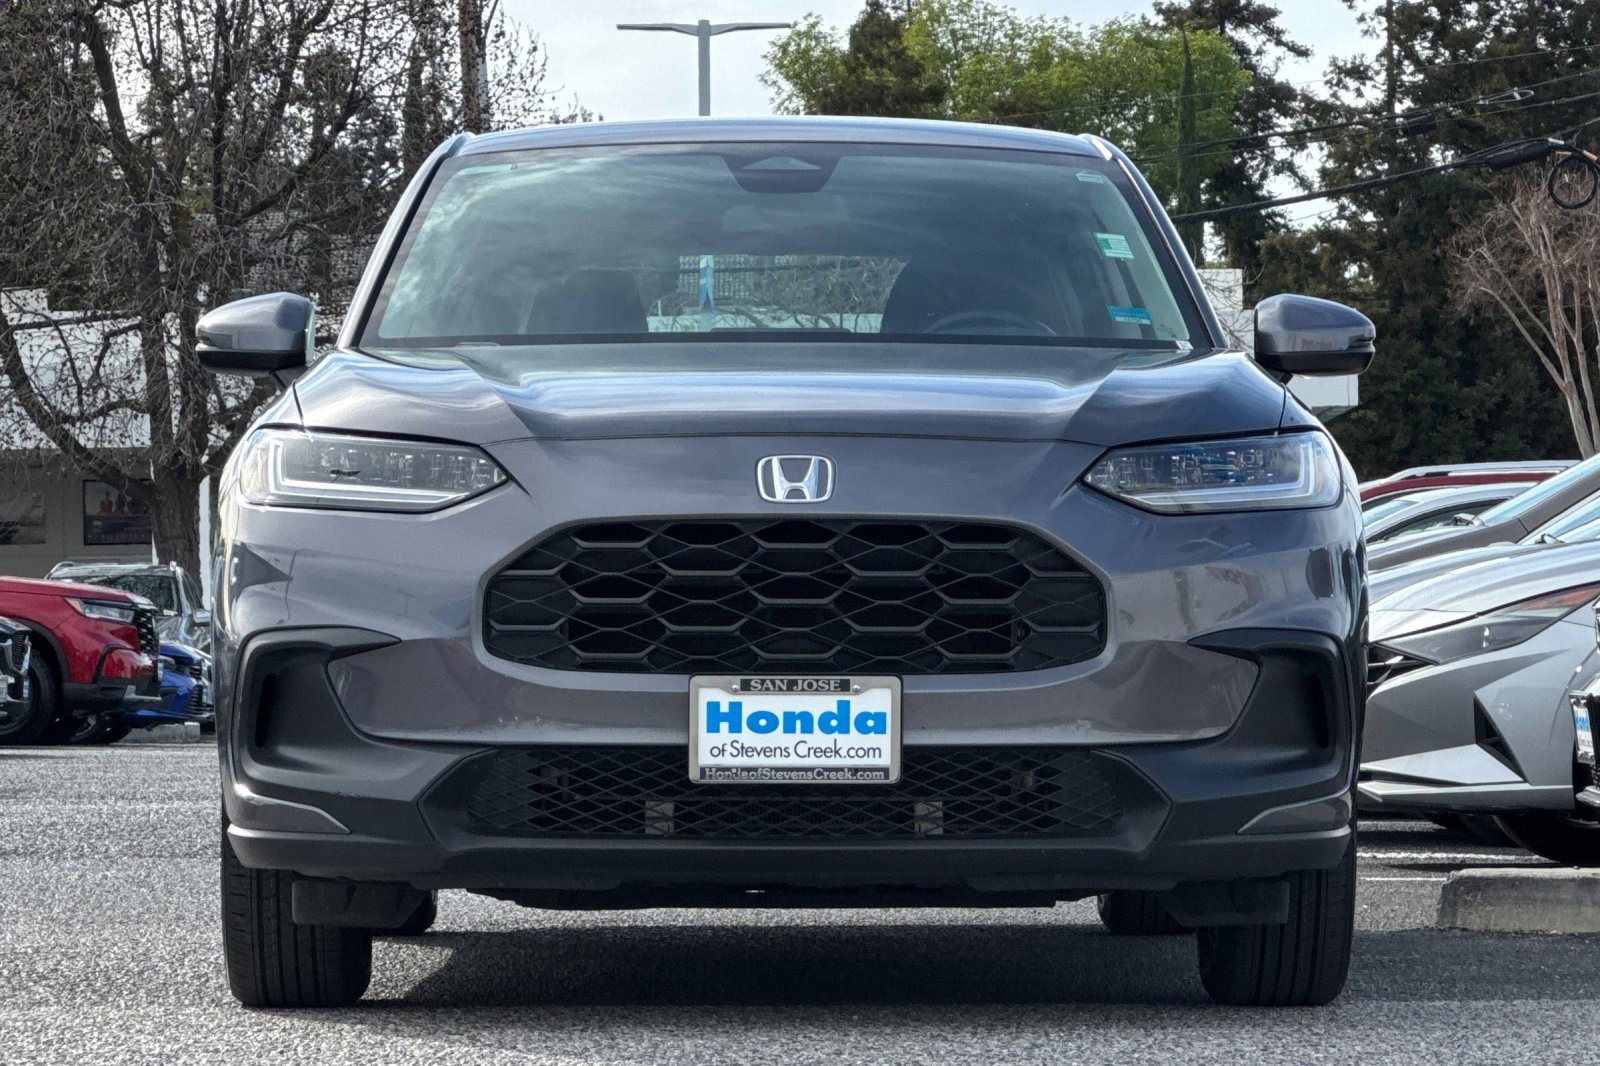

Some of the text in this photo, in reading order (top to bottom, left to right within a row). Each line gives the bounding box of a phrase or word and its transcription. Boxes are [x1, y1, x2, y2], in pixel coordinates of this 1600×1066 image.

[749, 679, 841, 691] SAN JOSE
[706, 699, 887, 735] Honda
[709, 738, 882, 759] of Stevens Creek.com
[704, 767, 885, 780] HondaofStevensCreek.com
